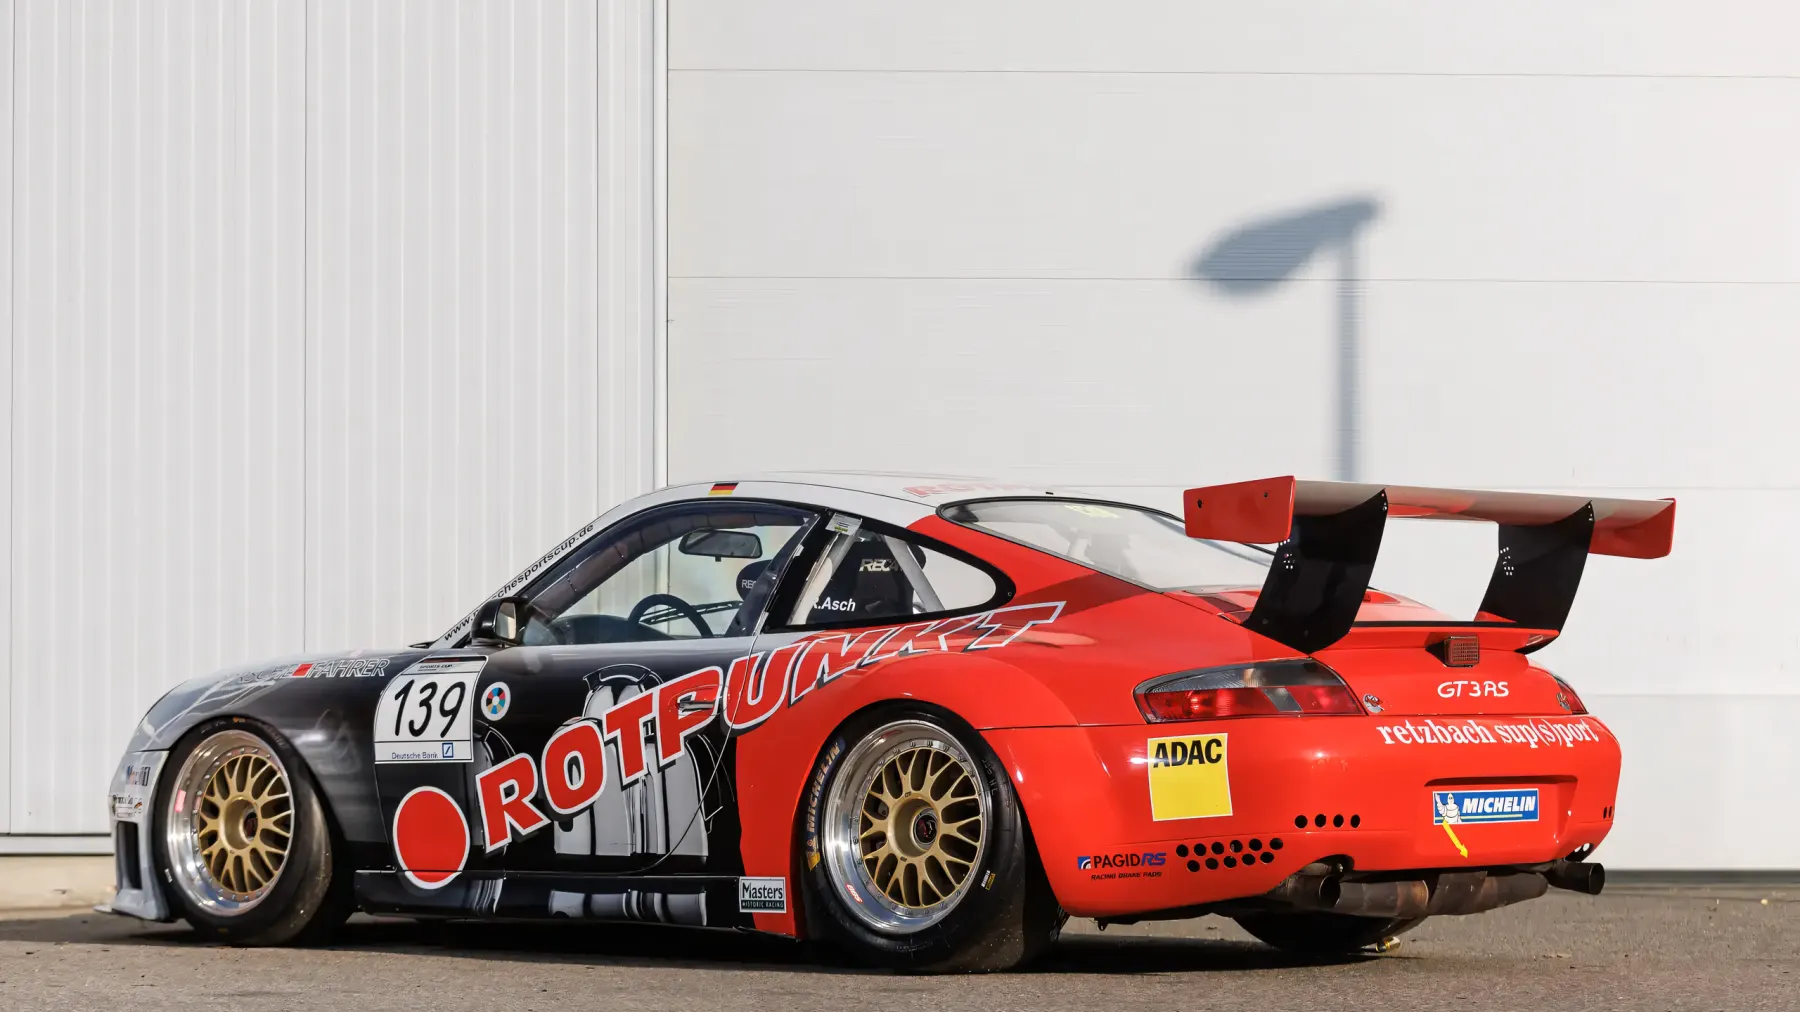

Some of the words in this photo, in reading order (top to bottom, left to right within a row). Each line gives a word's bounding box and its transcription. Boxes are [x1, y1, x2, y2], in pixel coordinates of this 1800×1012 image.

[305, 659, 390, 679] FAHRER
[394, 679, 466, 738] 139
[475, 601, 1067, 854] ROTPUNKT
[1376, 719, 1497, 745] retzbach
[392, 752, 421, 760] Deutsche
[422, 751, 438, 759] Bank
[1153, 738, 1222, 768] ADAC
[807, 742, 840, 833] MICHELIN
[1462, 796, 1536, 814] MICHELIN
[1091, 873, 1116, 881] RACING
[742, 881, 783, 899] Masters
